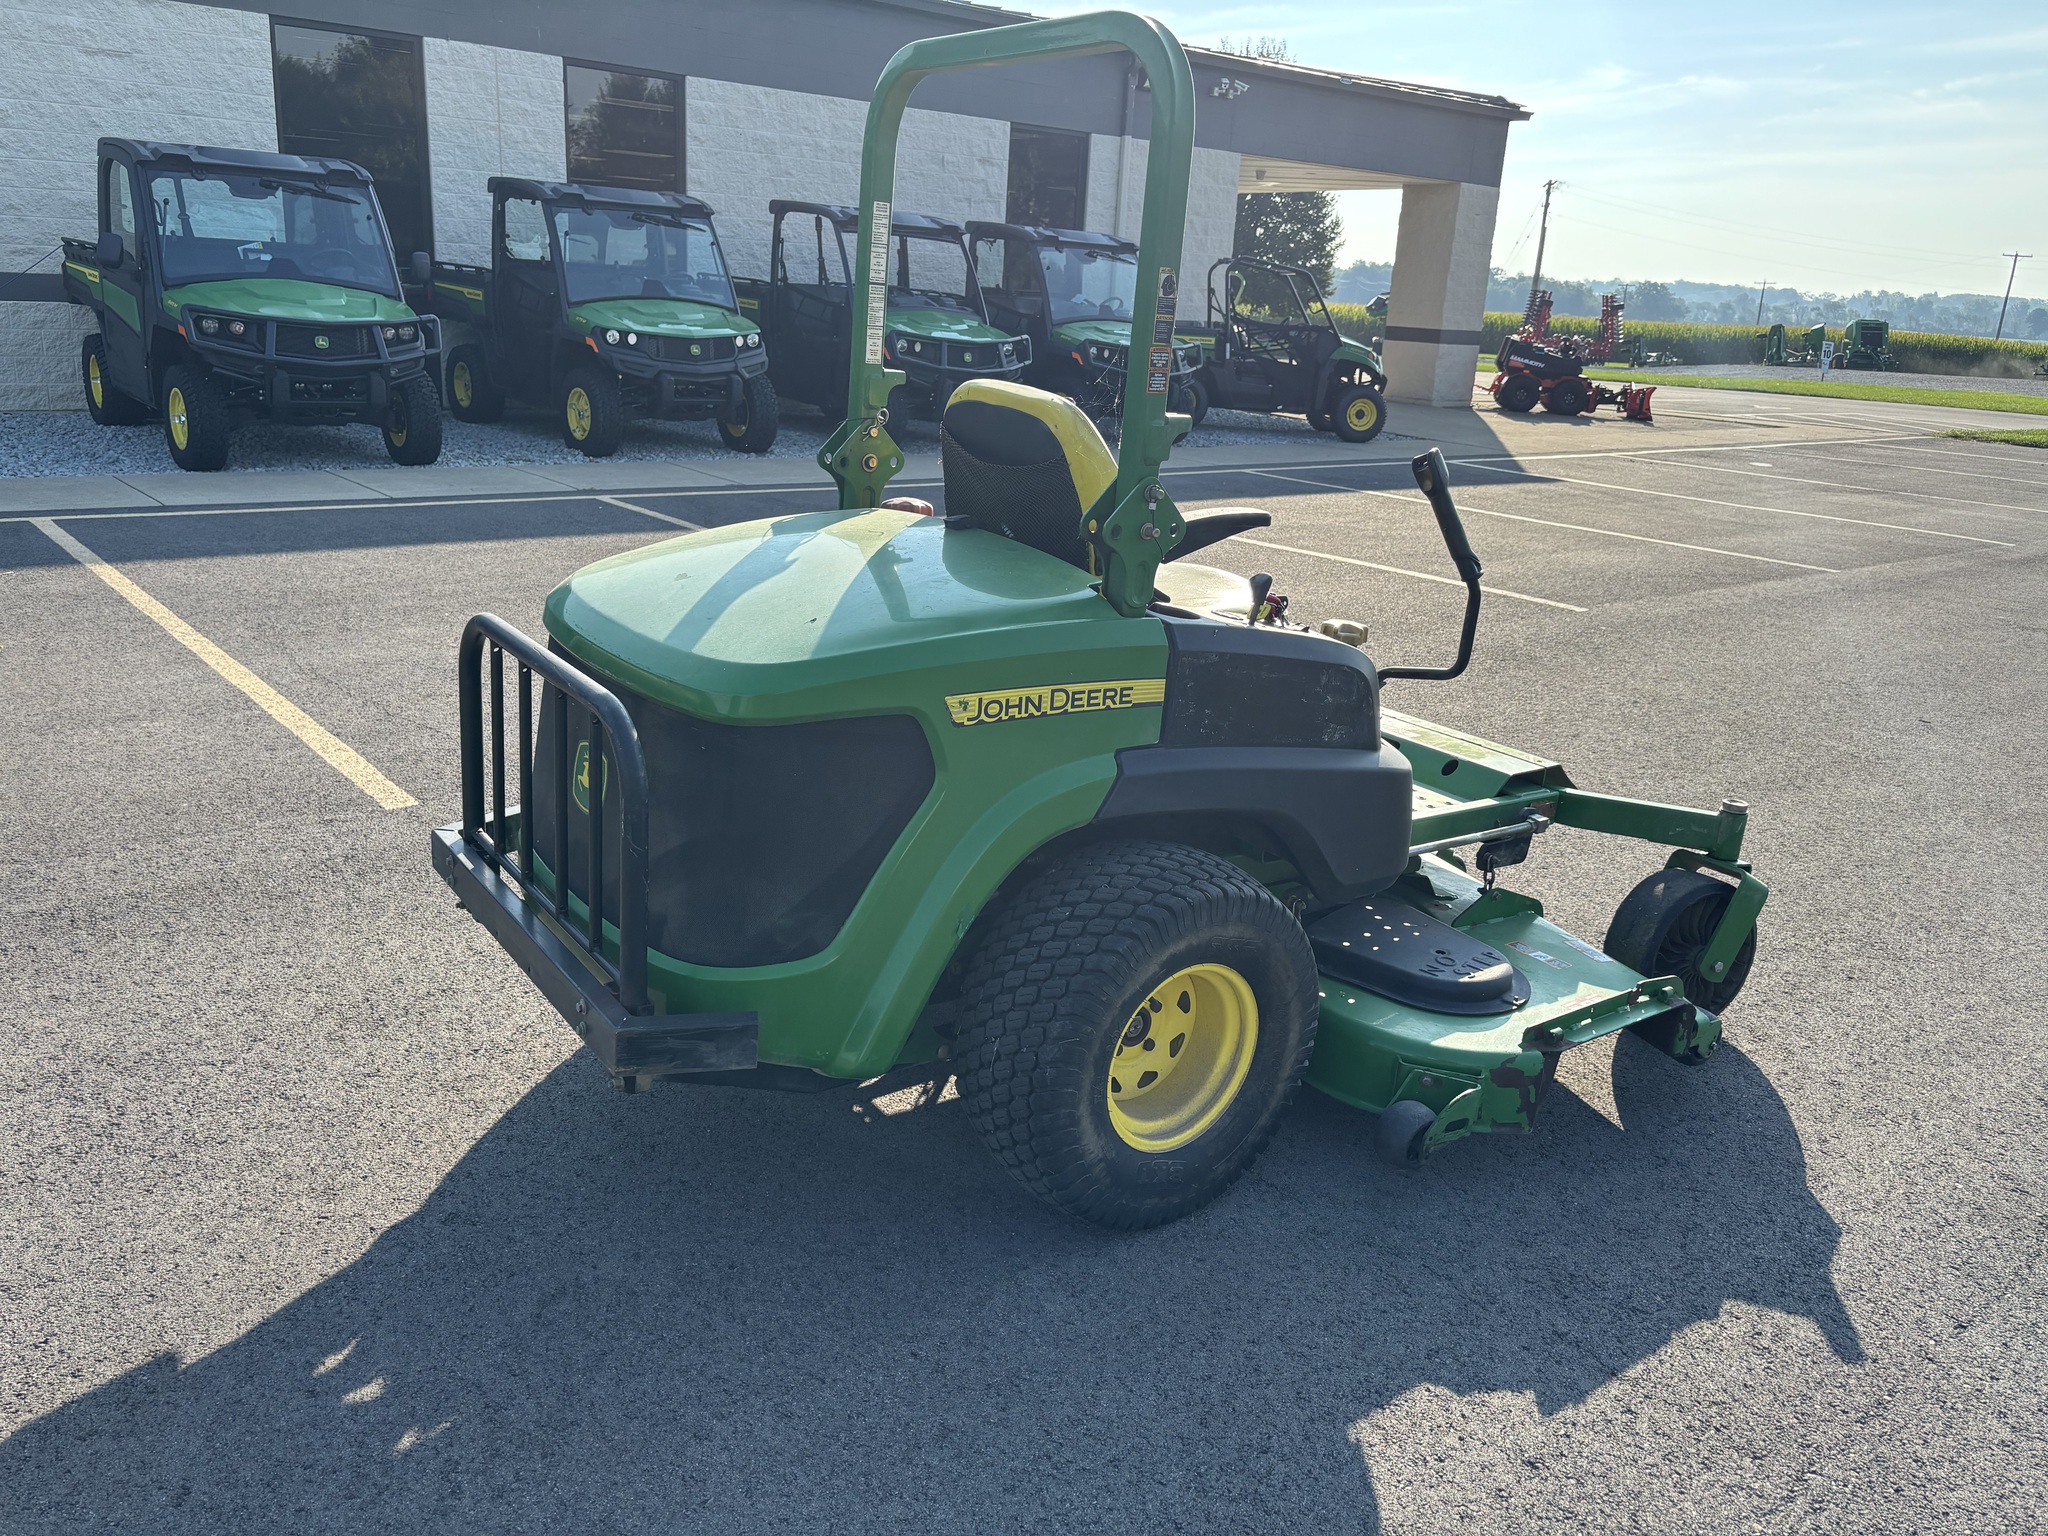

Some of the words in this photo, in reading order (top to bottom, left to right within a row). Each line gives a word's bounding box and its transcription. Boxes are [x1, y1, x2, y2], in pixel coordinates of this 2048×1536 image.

[1510, 354, 1546, 369] MAMMOTH
[1823, 349, 1831, 359] 10
[966, 694, 1043, 722] JOHN
[1050, 686, 1134, 712] DEERE
[1418, 955, 1458, 977] NO
[1452, 951, 1502, 979] STEP
